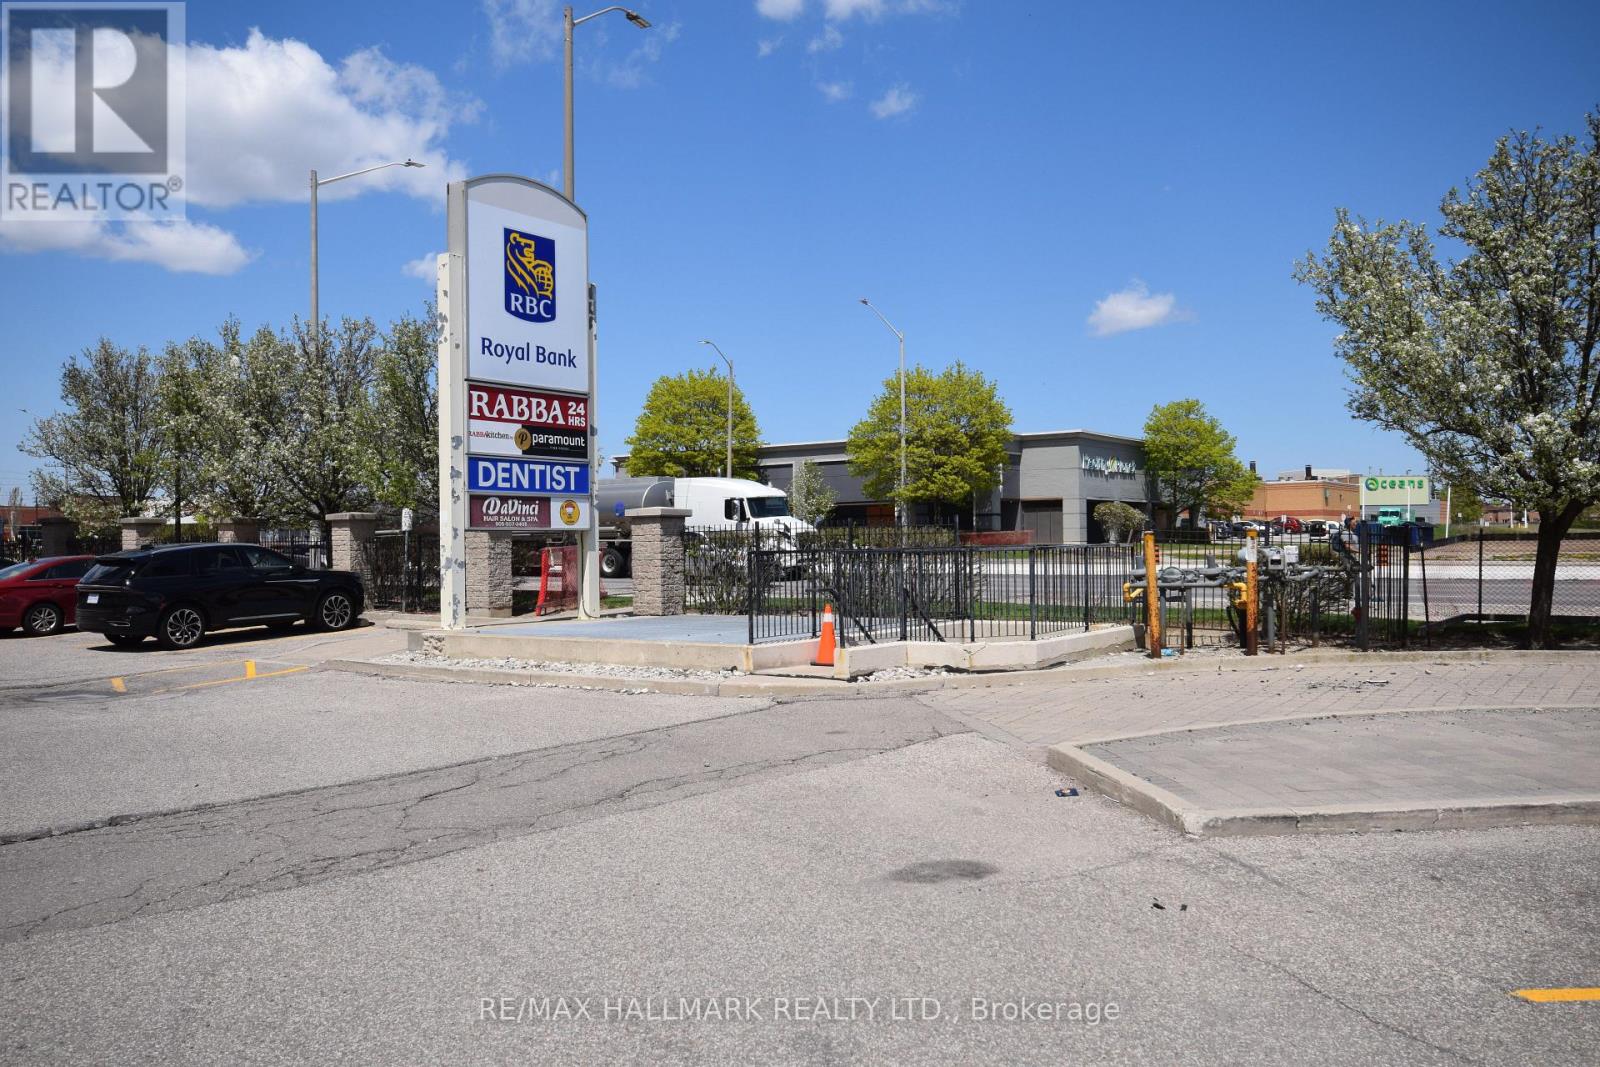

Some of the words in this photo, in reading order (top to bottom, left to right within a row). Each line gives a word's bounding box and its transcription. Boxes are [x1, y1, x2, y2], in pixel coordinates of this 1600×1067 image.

[510, 292, 552, 318] RBC
[480, 336, 530, 365] Royal
[536, 345, 577, 369] Bank
[469, 390, 566, 425] RABBA
[567, 401, 586, 416] 24
[567, 416, 586, 427] HRS
[532, 432, 586, 447] paramount
[478, 460, 580, 491] DENTIST
[482, 497, 539, 515] DaVinci
